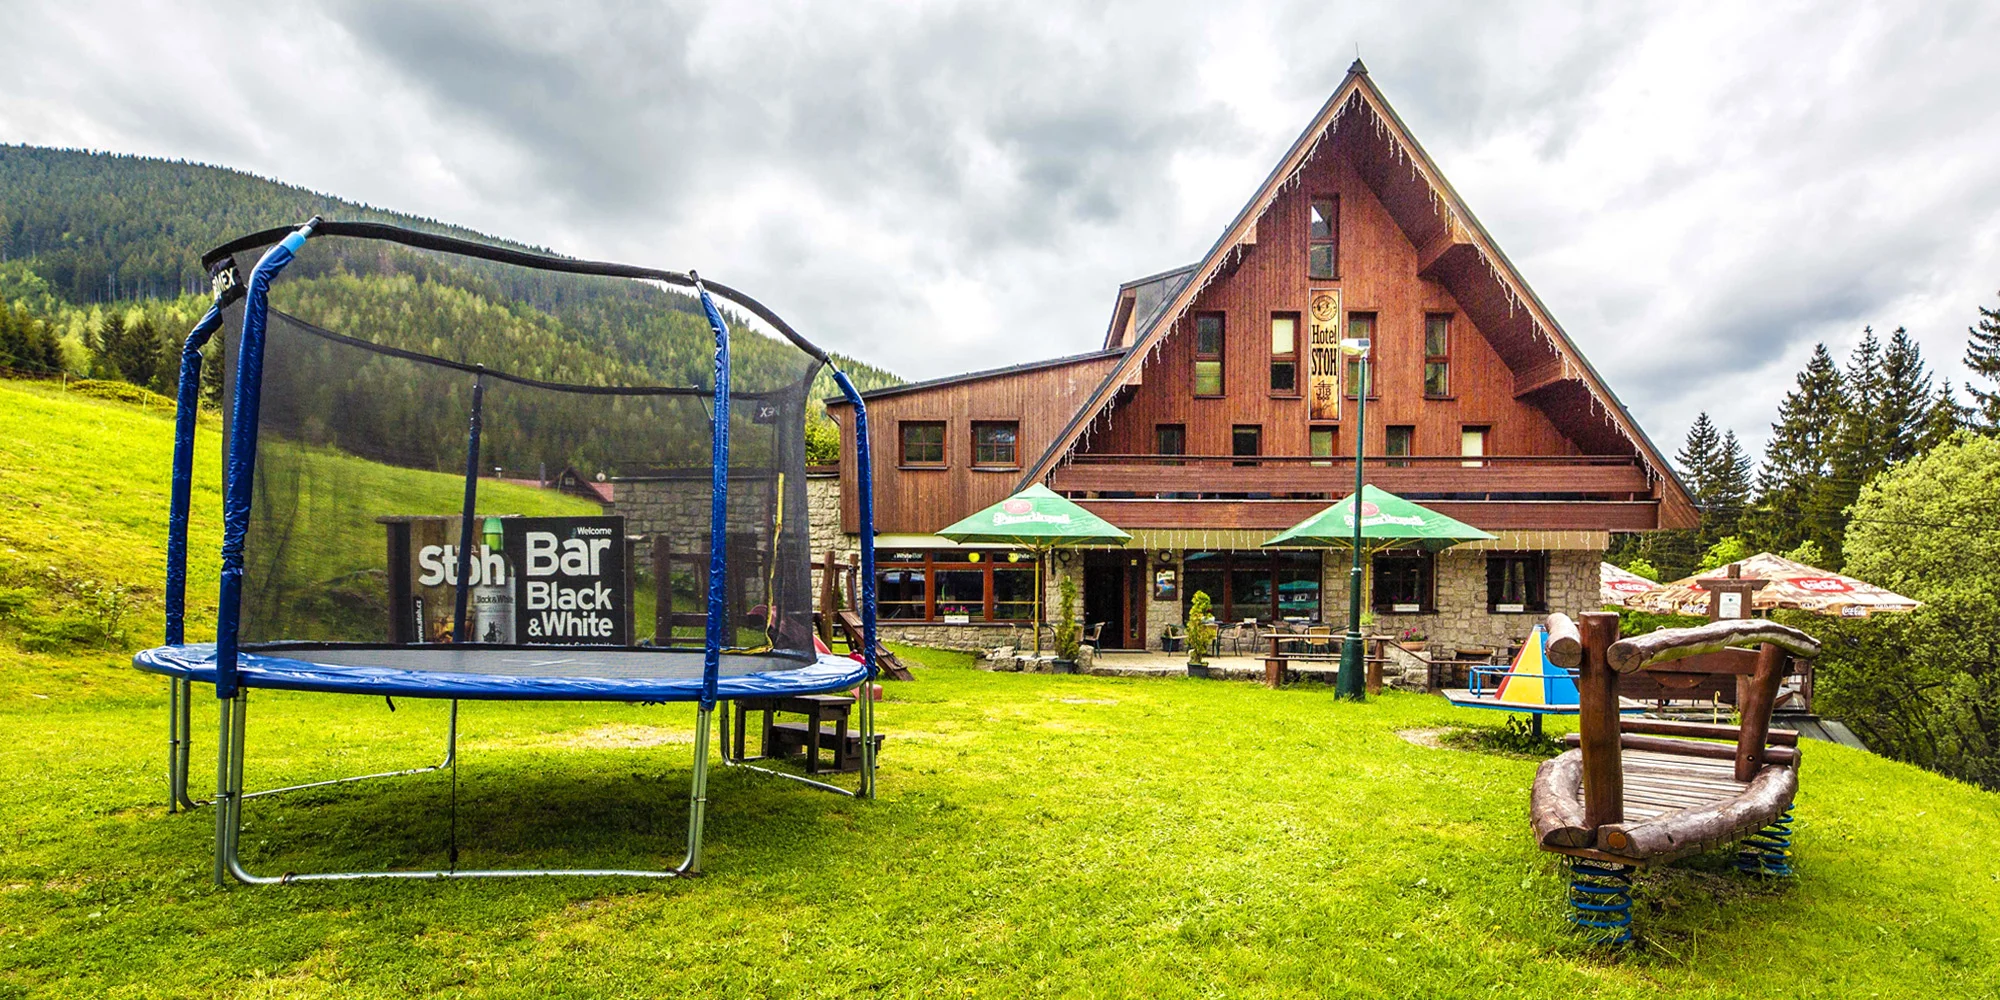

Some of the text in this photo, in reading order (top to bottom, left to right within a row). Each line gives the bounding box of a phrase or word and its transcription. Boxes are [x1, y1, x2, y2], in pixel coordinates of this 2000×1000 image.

[1311, 324, 1337, 344] Hotel
[1311, 348, 1337, 376] STOH
[577, 526, 612, 535] Welcome
[526, 531, 612, 576] Bar
[527, 581, 613, 610] Black
